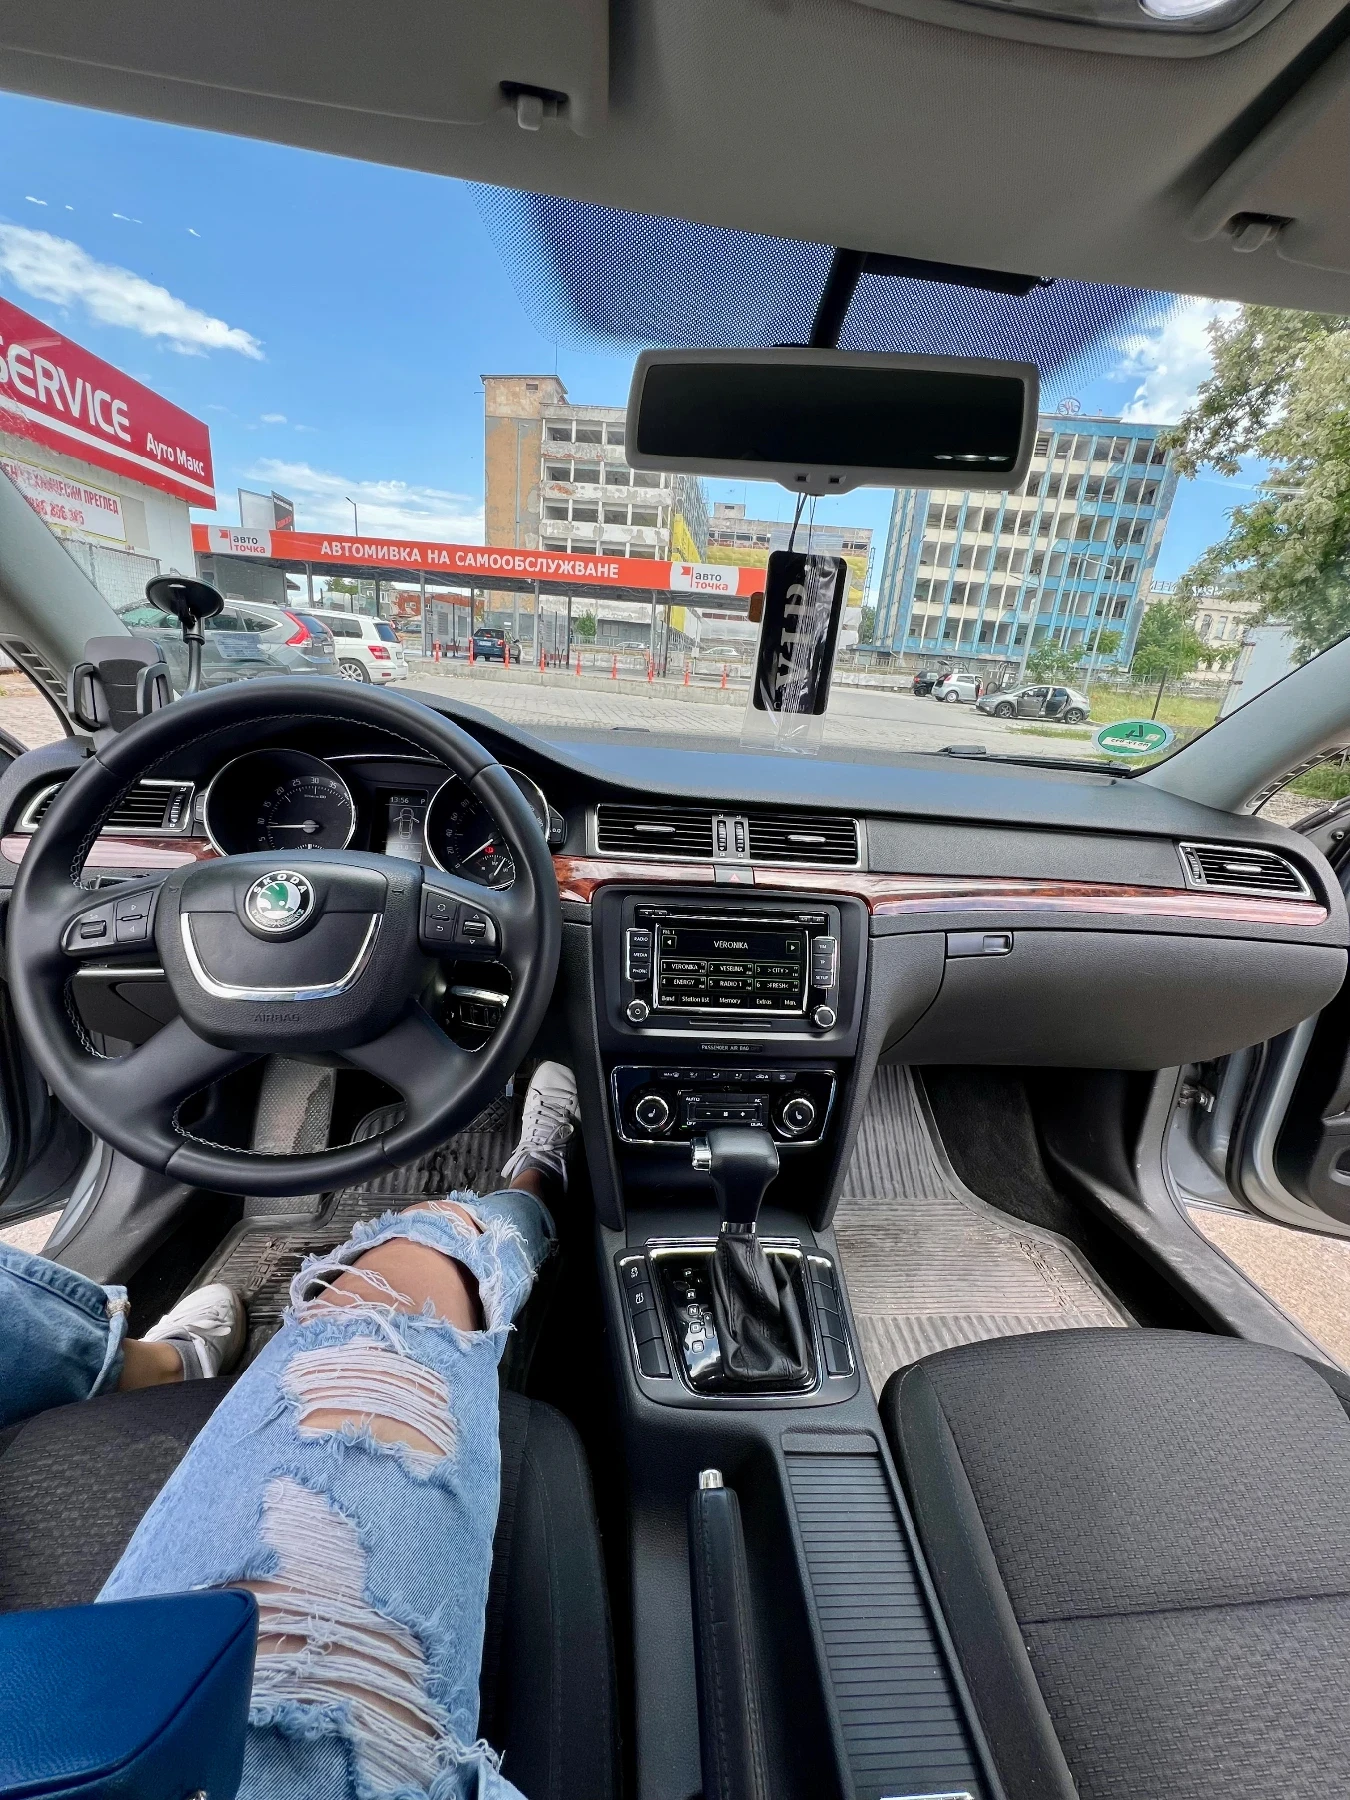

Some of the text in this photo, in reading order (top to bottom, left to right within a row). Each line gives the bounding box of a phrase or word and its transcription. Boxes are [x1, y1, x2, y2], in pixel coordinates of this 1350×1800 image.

[146, 432, 205, 477] Ауто Макс
[233, 535, 258, 545] авто
[234, 544, 266, 554] точка
[321, 541, 619, 579] АВТОМИВКА НА САМООБСЛУЖВАНЕ
[695, 571, 722, 582] авто
[695, 581, 728, 591] точка
[713, 940, 749, 950] VERONIKA
[671, 963, 698, 971] VERONIKA
[254, 1013, 301, 1023] AIRBAG
